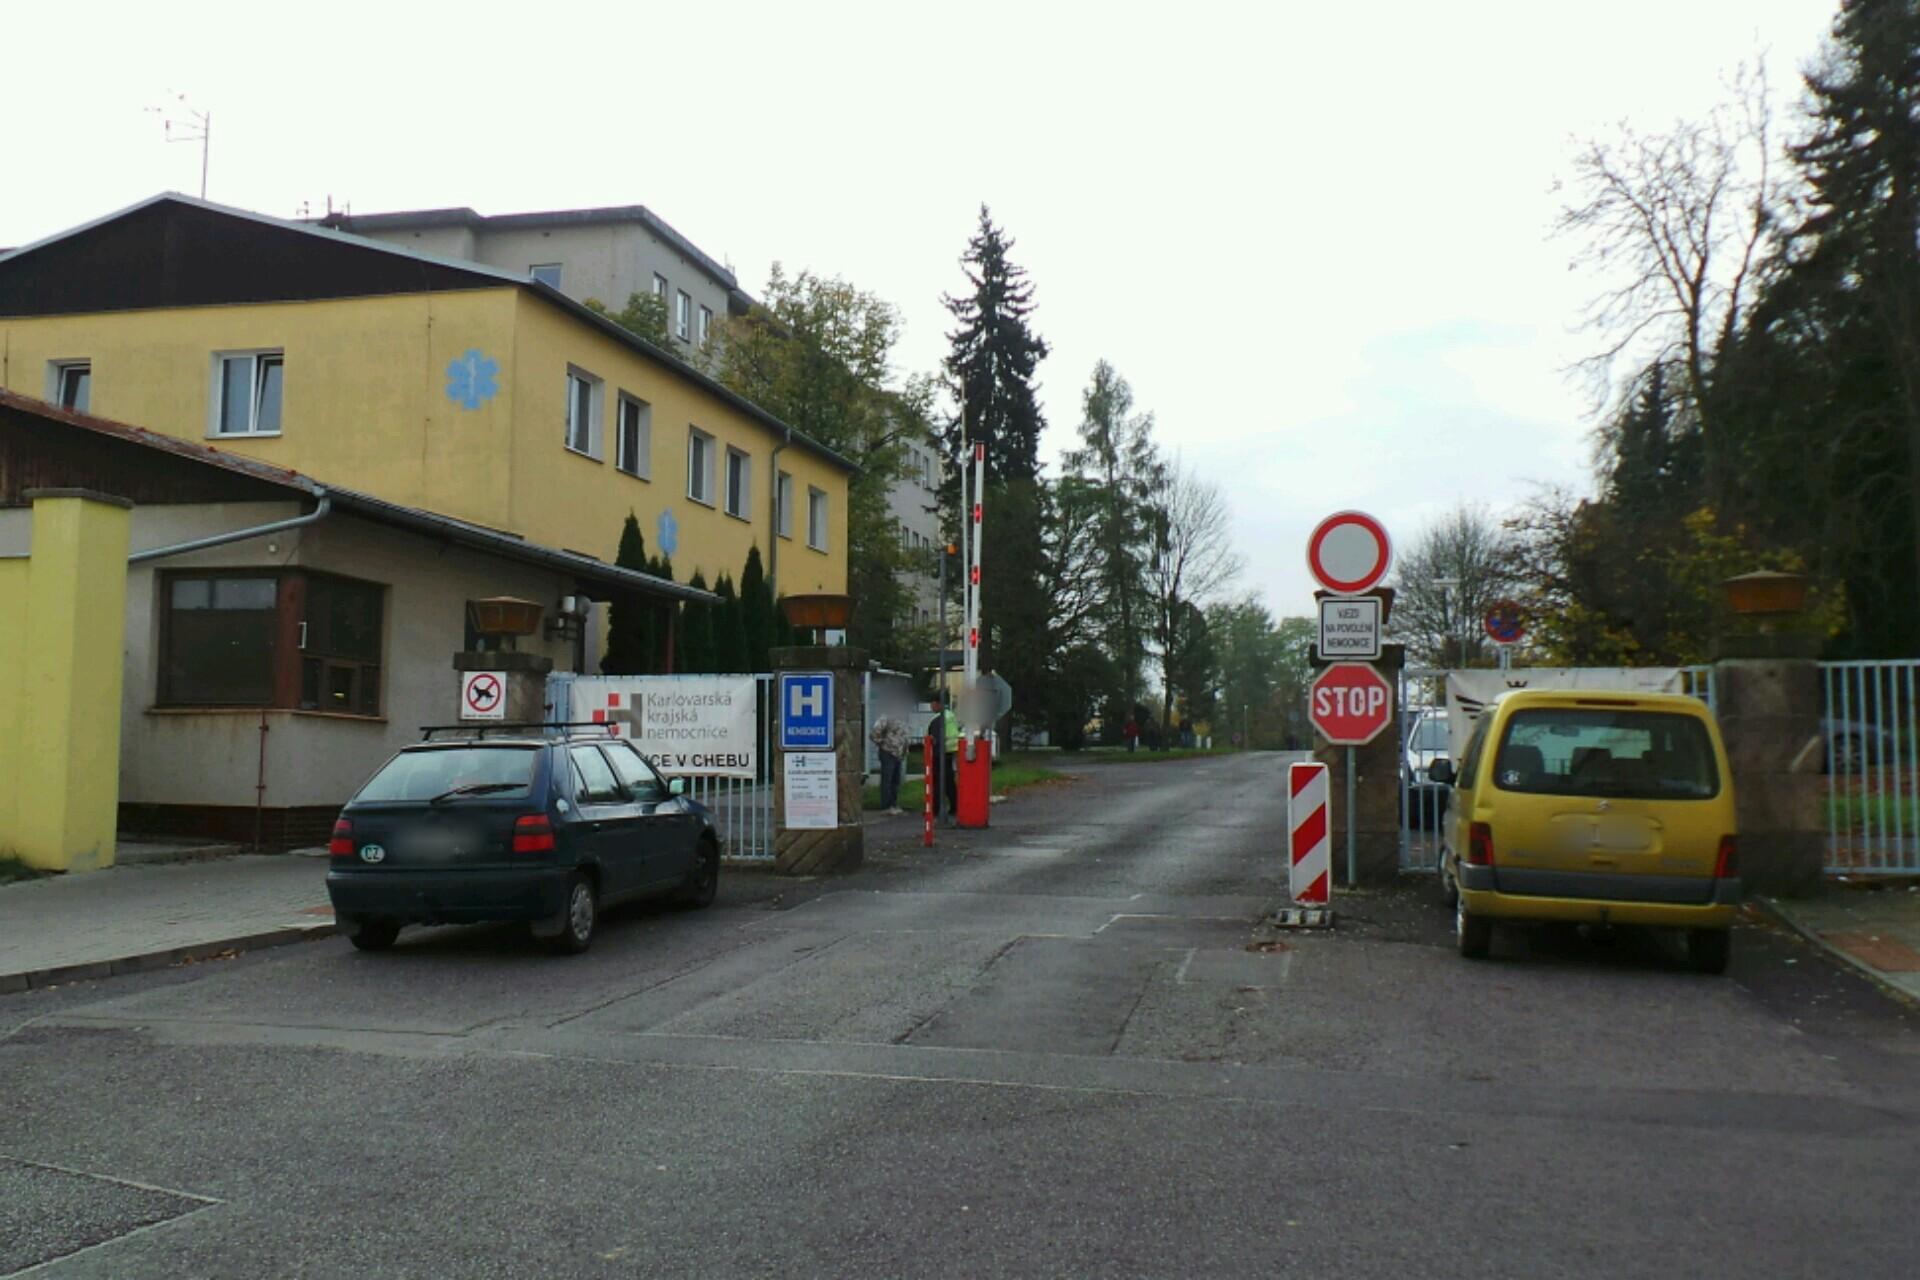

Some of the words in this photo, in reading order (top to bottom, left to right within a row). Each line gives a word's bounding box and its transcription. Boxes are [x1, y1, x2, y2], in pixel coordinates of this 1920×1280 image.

[1325, 623, 1336, 633] NA
[1327, 637, 1370, 648] NEMOCNICE
[647, 692, 732, 707] Karlovarská
[791, 685, 823, 716] H
[1316, 686, 1385, 717] STOP
[647, 708, 698, 726] krajská
[647, 726, 728, 739] nemocnice
[676, 754, 689, 767] V
[691, 753, 749, 767] CHEBU
[365, 847, 380, 860] CZ
